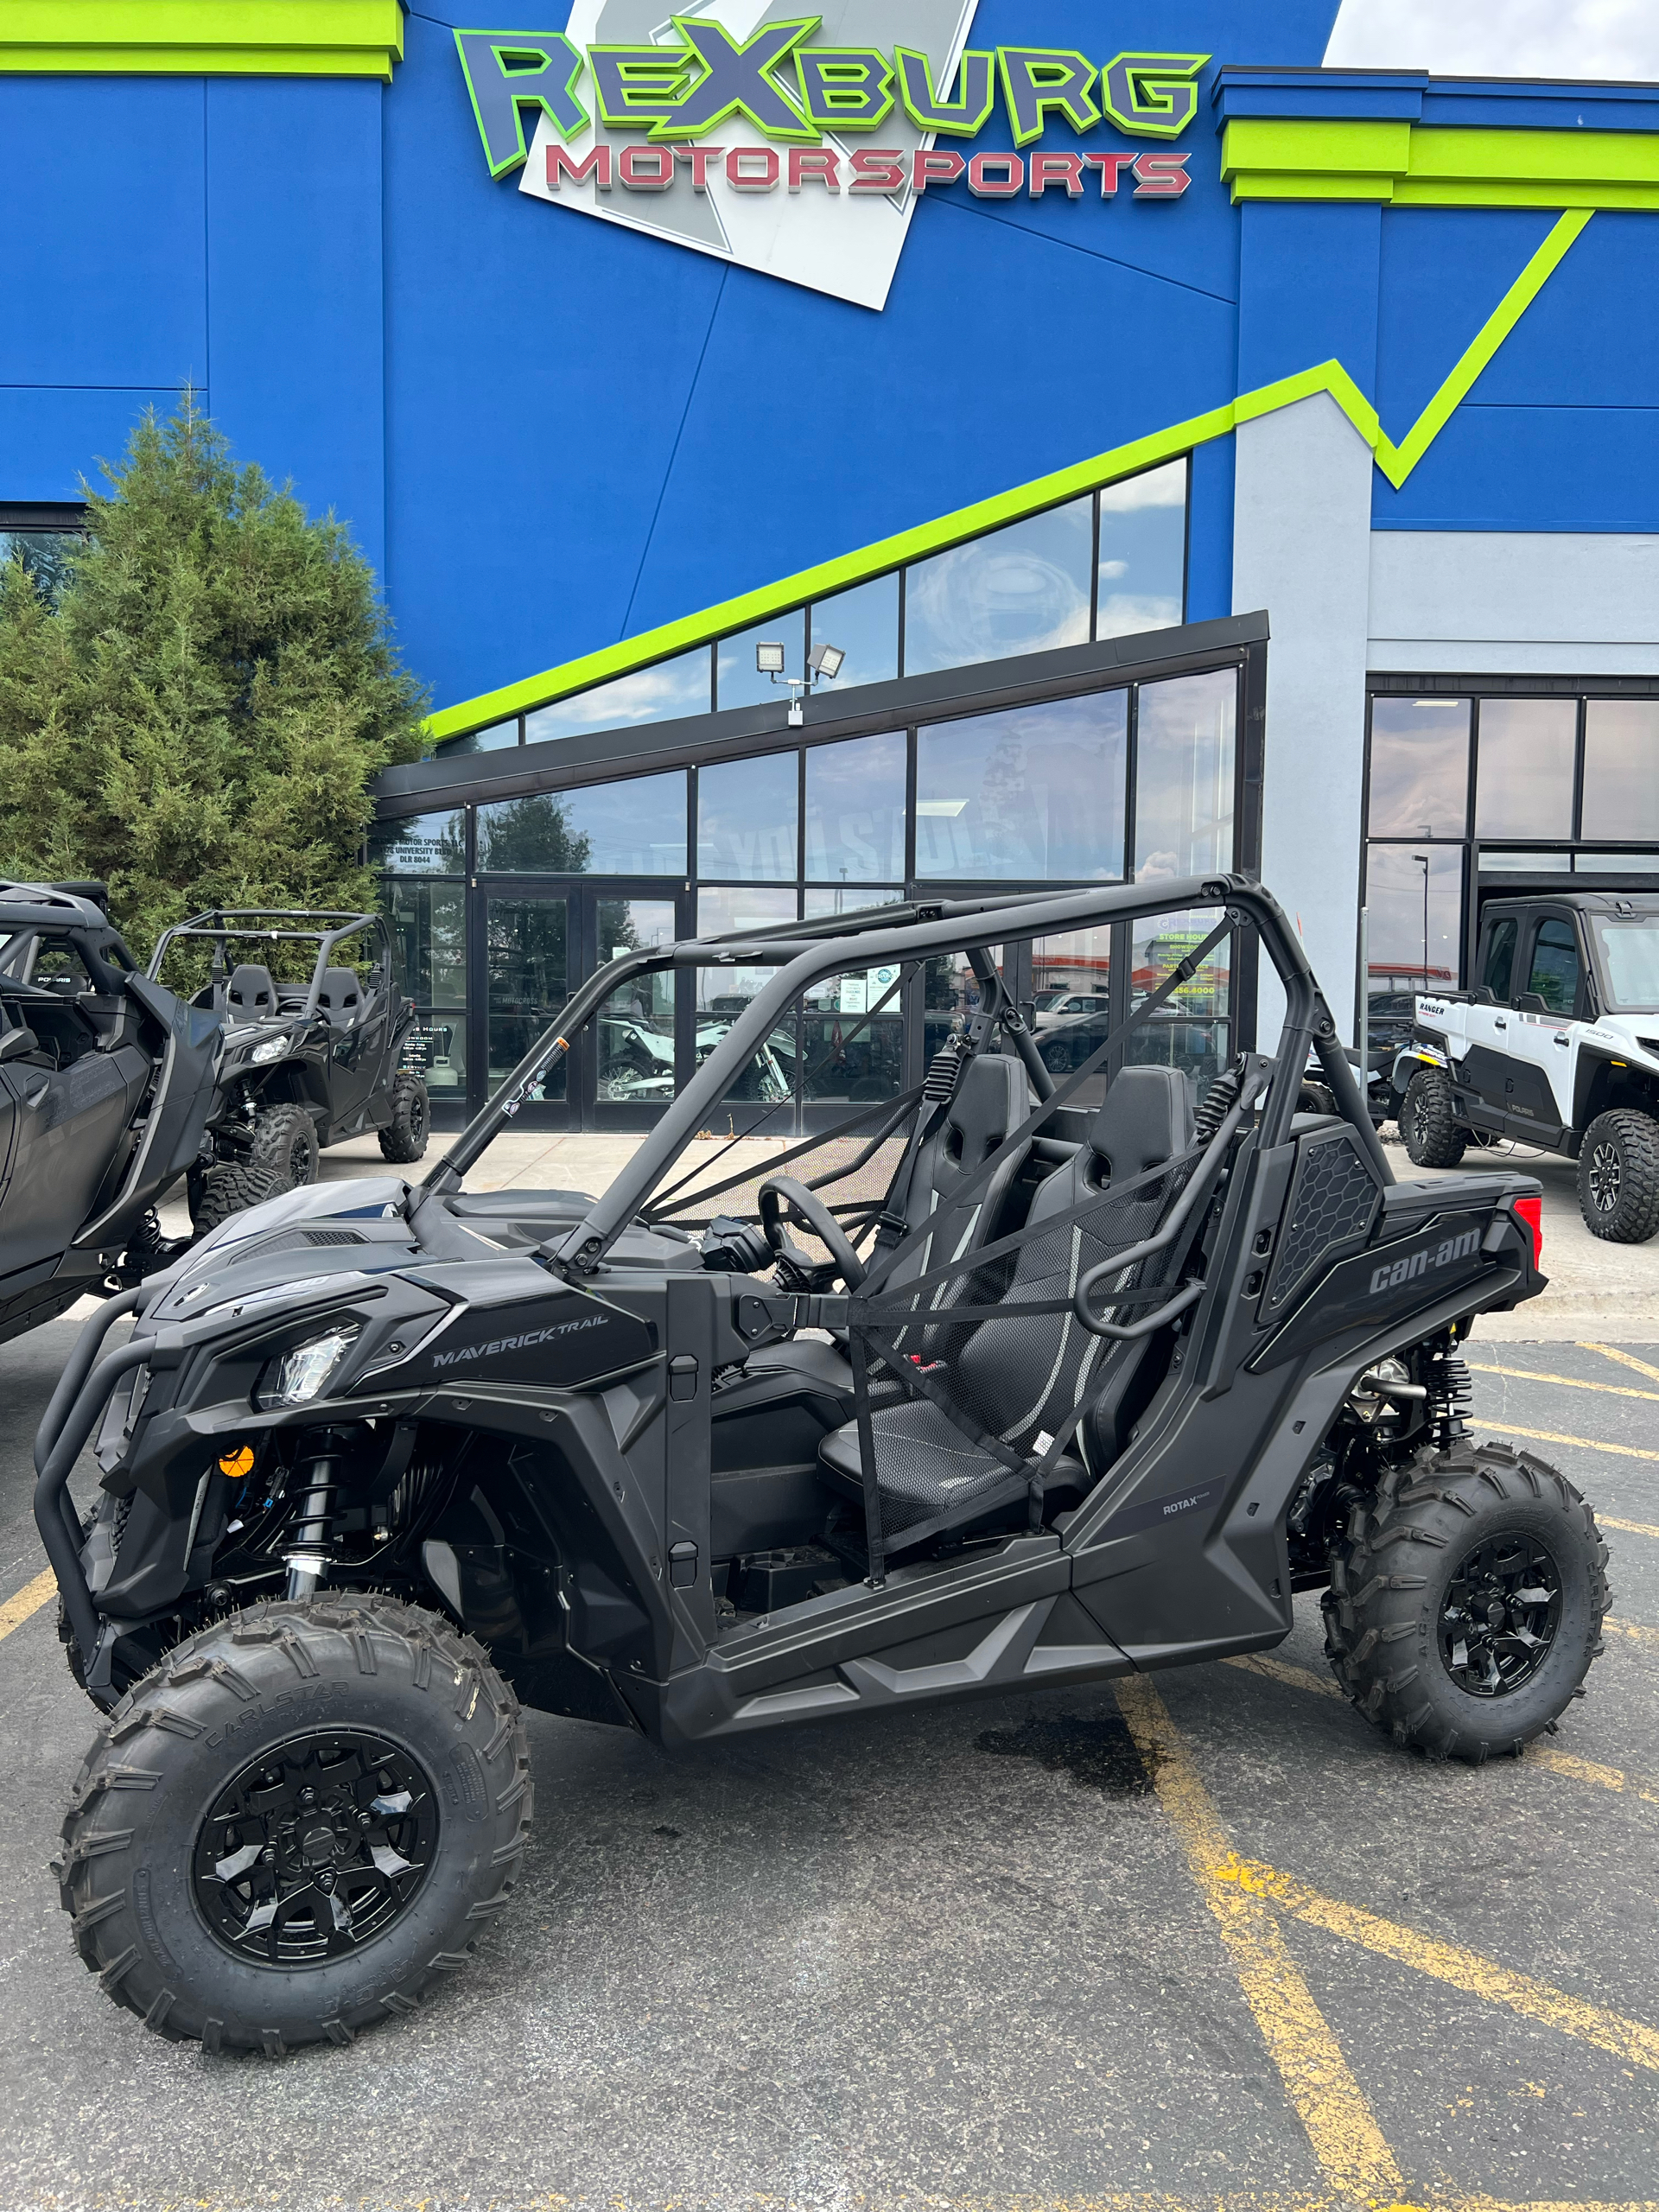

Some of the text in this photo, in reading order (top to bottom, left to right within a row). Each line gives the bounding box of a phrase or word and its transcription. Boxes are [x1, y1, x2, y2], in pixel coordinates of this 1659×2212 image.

[454, 16, 1213, 181] REXBURG
[545, 143, 1192, 199] MOTORSPORTS
[413, 855, 431, 864] 8044
[1419, 1002, 1445, 1015] RANGER
[1585, 1028, 1614, 1039] 1500
[1511, 1104, 1535, 1117] POLARIS
[1370, 1228, 1480, 1294] can-am
[433, 1315, 609, 1368] MAVERICK TRAIL
[1163, 1496, 1198, 1516] ROTAX
[202, 1679, 351, 1752] CARLSTAR
